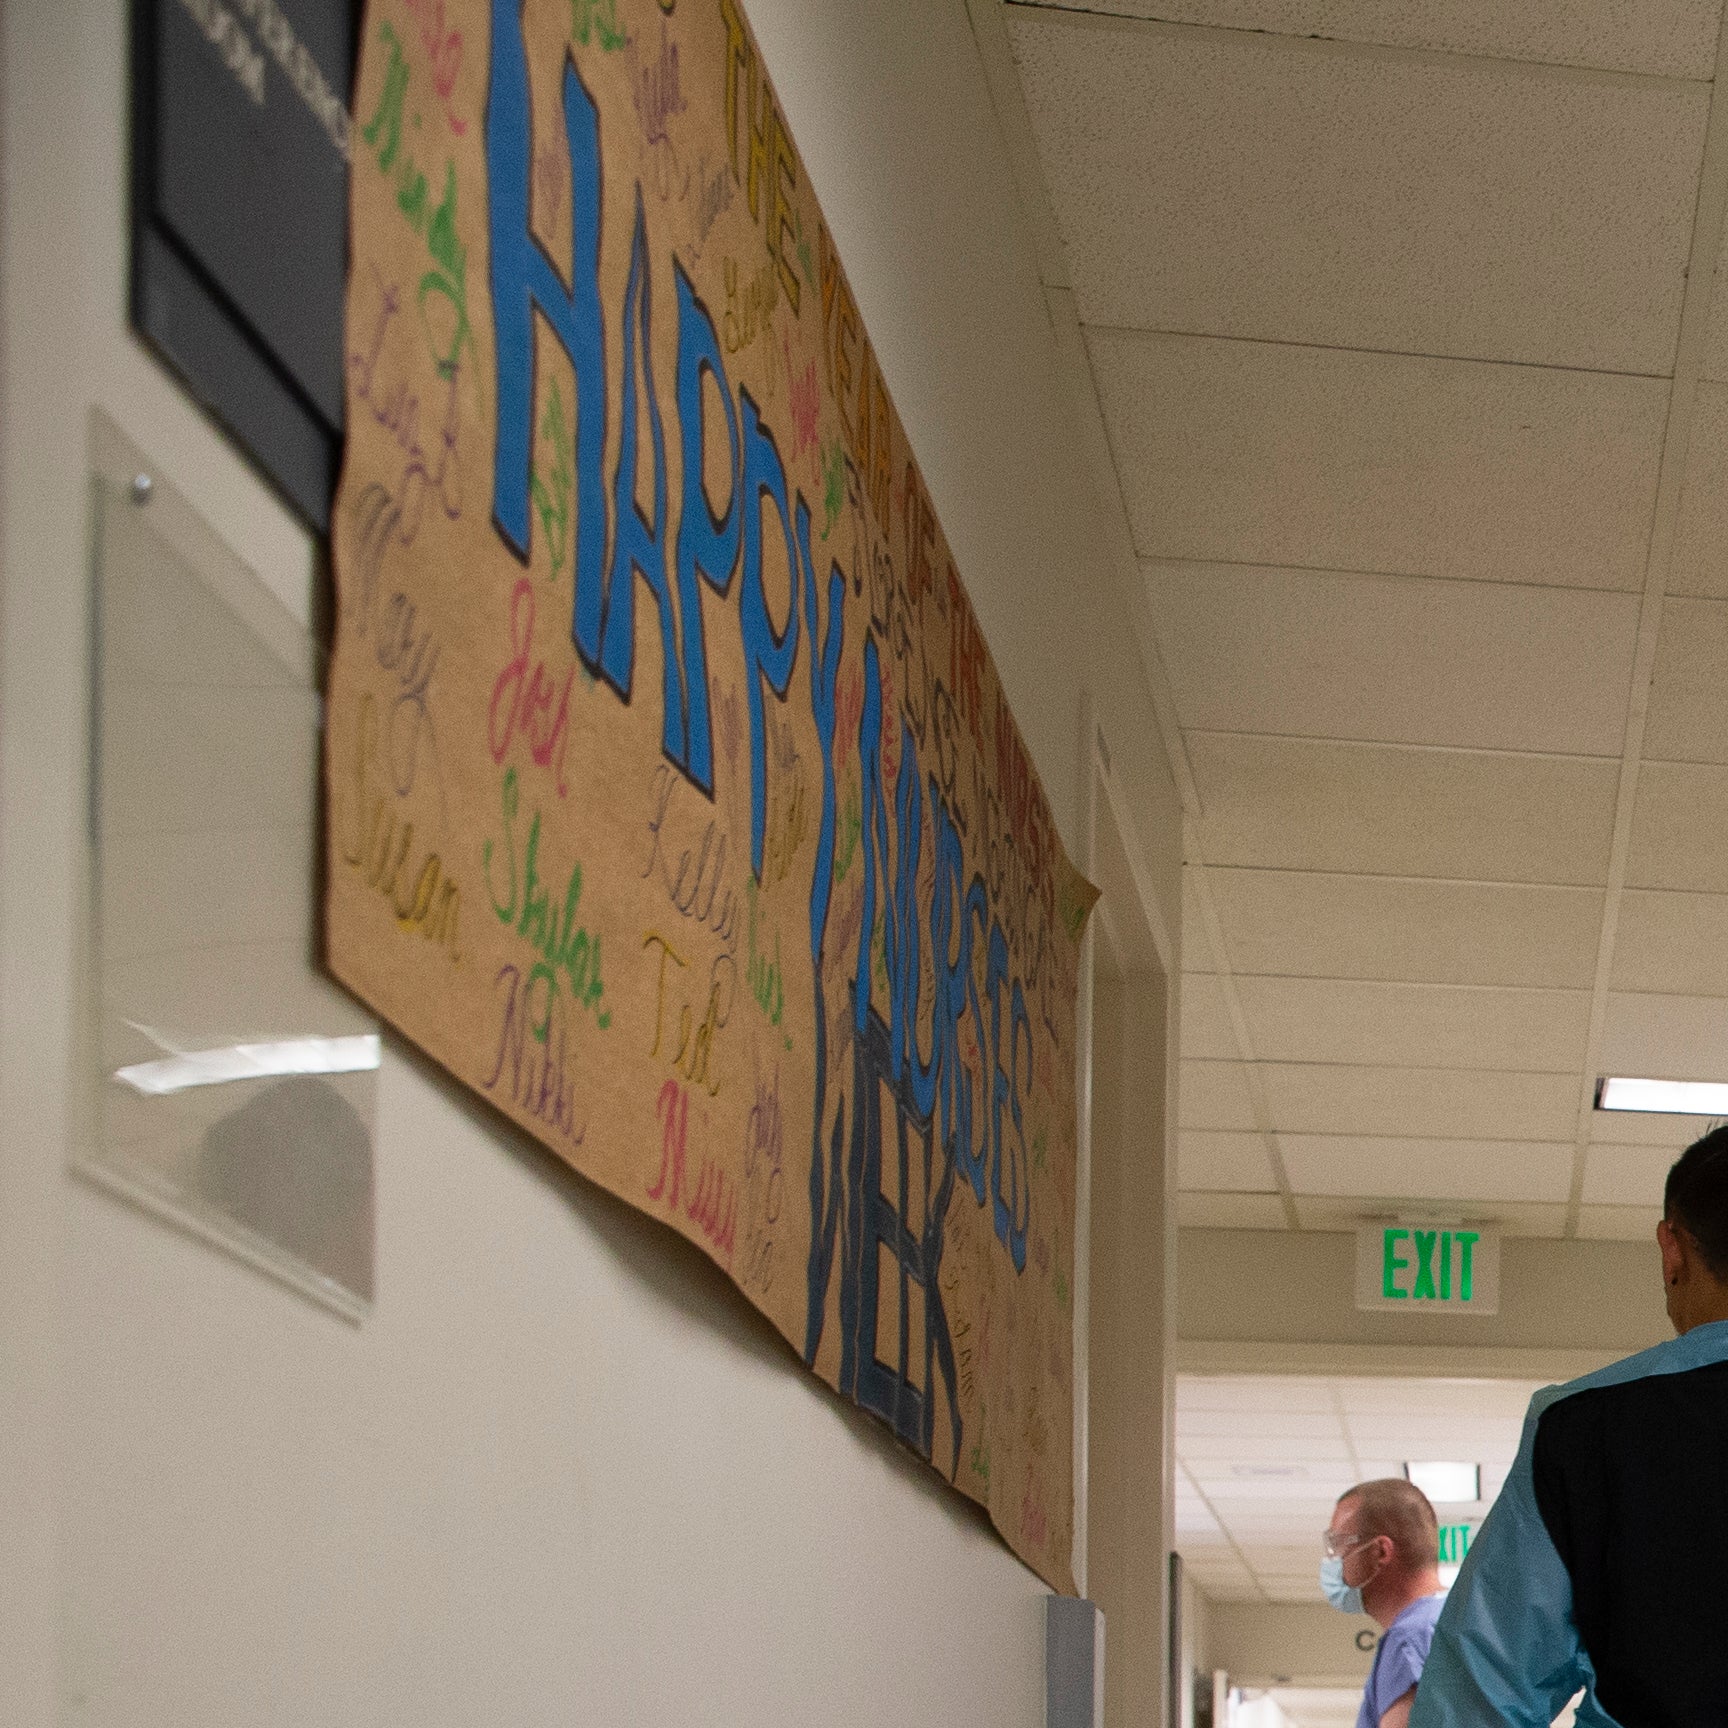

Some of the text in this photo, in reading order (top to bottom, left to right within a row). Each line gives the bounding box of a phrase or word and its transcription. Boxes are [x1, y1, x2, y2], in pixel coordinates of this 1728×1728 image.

[720, 0, 800, 321] THE
[484, 0, 1033, 1276] HAPPY NURSES
[804, 958, 963, 1485] WEEK
[1383, 1229, 1479, 1301] EXIT
[1438, 1524, 1471, 1562] XIT
